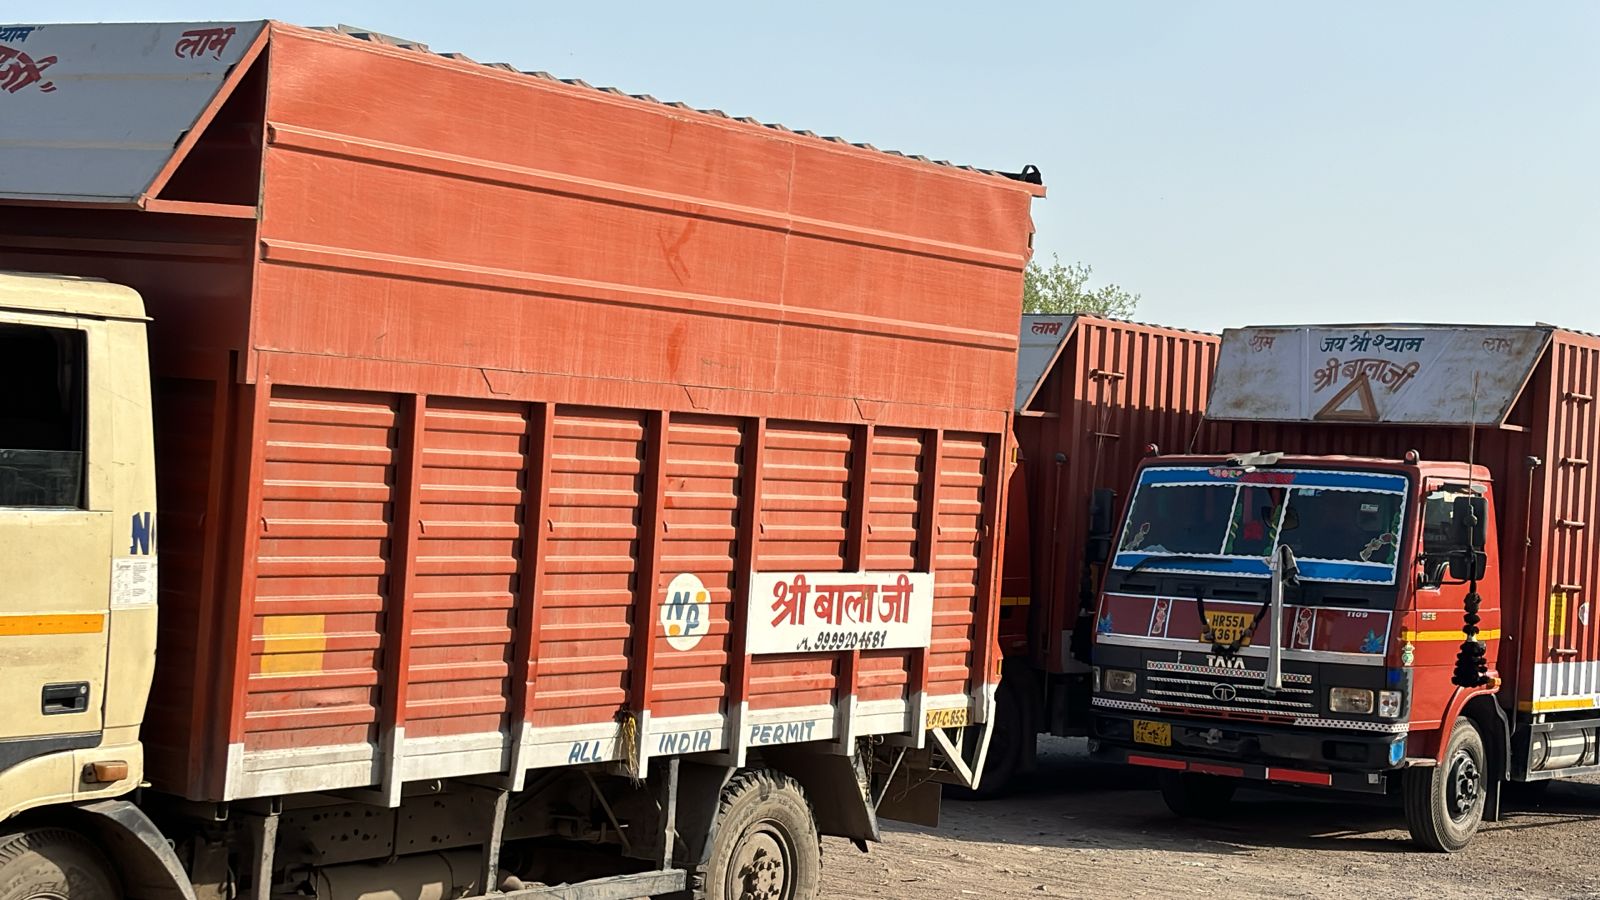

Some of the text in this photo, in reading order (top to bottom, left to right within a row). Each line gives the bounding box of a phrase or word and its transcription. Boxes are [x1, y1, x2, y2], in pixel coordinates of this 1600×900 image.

[1320, 330, 1424, 352] जय श्री श्याम
[1313, 357, 1341, 393] श्री
[771, 574, 811, 628] श्री
[1212, 614, 1246, 628] HR55A
[1206, 654, 1246, 670] TATA
[568, 721, 816, 764] ALL INDIA PERMIT
